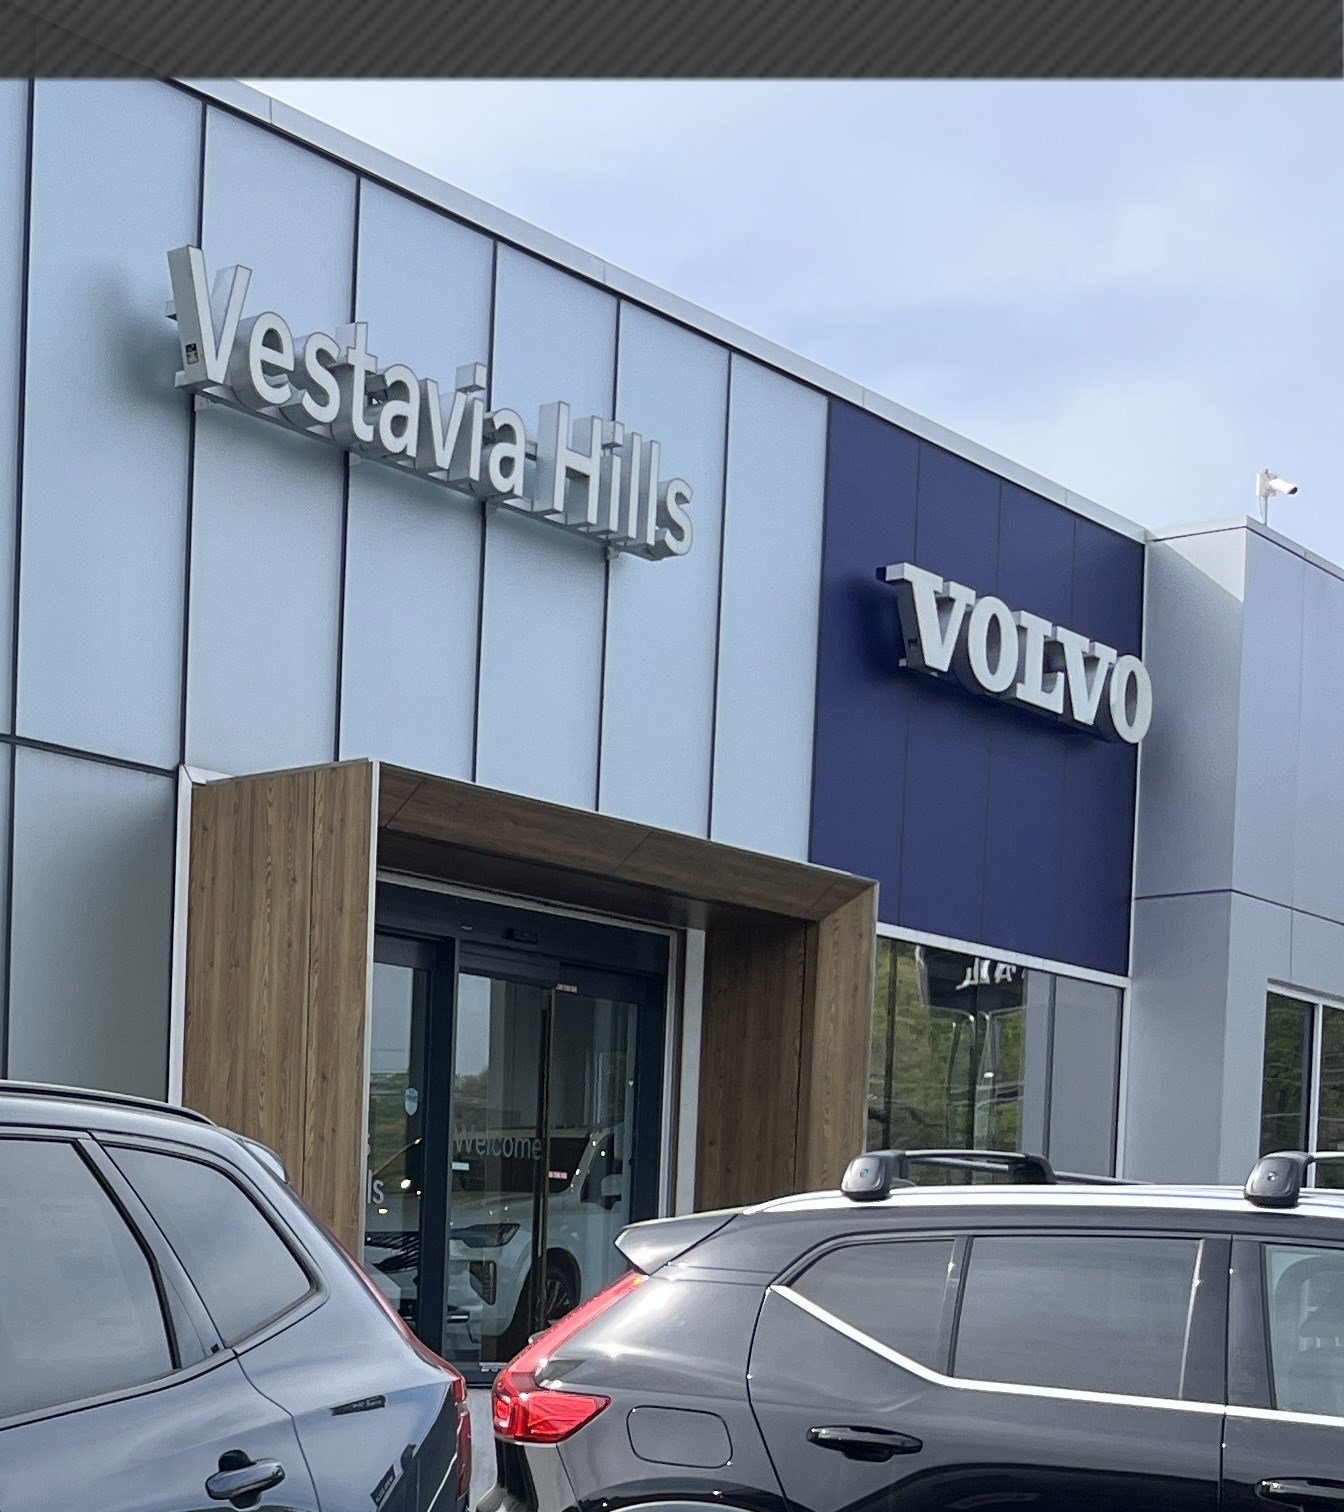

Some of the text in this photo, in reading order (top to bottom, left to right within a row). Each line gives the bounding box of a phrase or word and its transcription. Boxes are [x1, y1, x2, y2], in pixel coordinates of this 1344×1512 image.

[168, 245, 694, 557] Vestavia Hills
[877, 562, 1153, 744] VOLVO
[453, 1124, 543, 1161] Welcome
